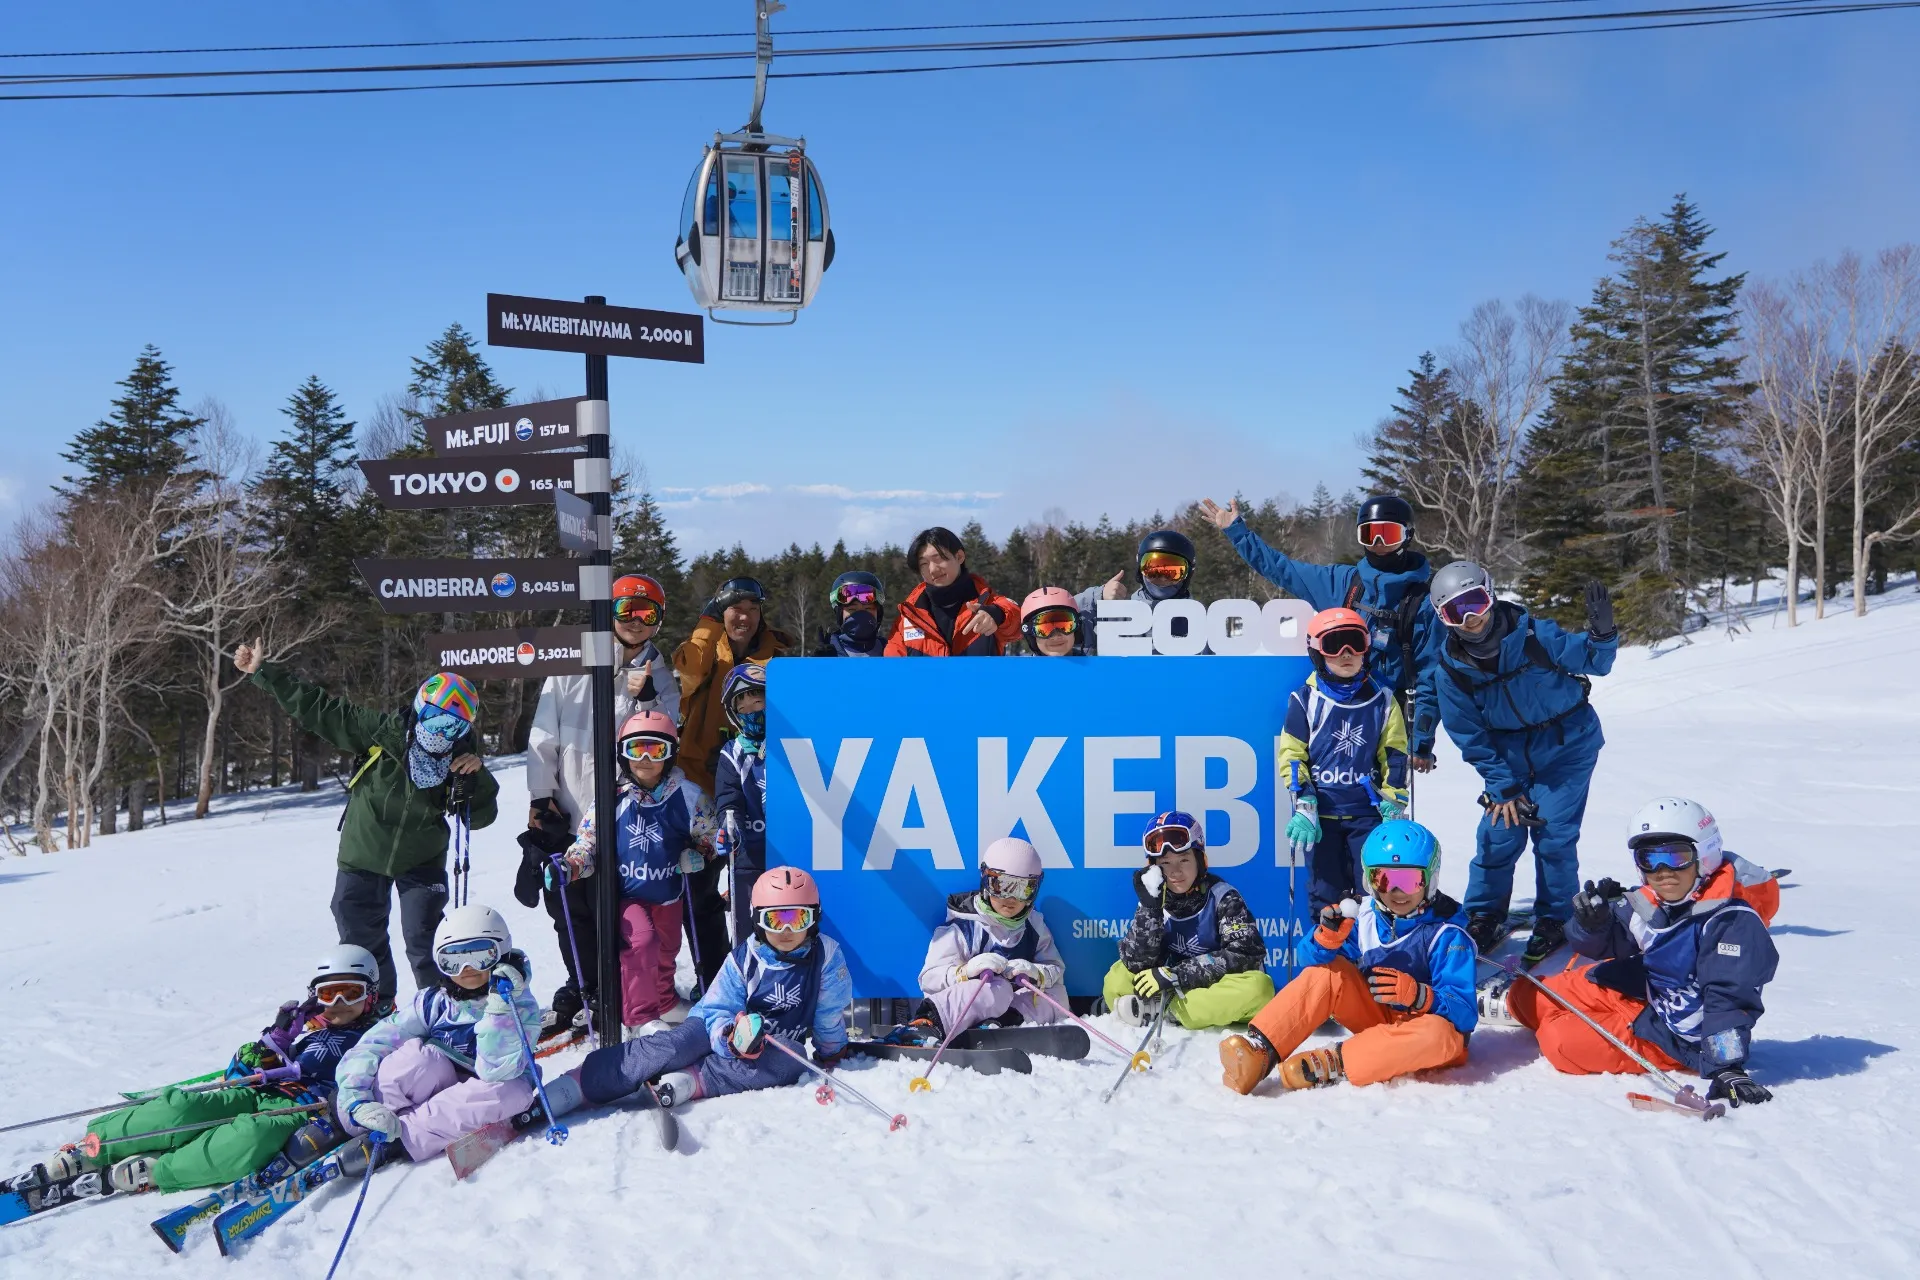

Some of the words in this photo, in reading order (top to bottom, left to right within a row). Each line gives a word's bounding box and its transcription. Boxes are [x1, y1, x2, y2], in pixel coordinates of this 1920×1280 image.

[501, 312, 633, 341] Mt.YAKEBITAIYAMA
[445, 422, 510, 449] Mt.FUJI
[539, 425, 556, 437] 157
[558, 423, 570, 435] km
[390, 471, 487, 496] TOKYO
[530, 479, 553, 490] 165
[557, 478, 573, 489] km
[380, 577, 489, 598] CANBERRA
[522, 581, 559, 594] 8,045
[562, 580, 575, 592] km
[1097, 599, 1314, 656] 2000
[440, 646, 515, 667] SINGAPORE
[538, 648, 569, 661] 5,302
[569, 648, 581, 658] km
[780, 735, 1305, 871] YAKEBI
[1263, 947, 1298, 967] APA
